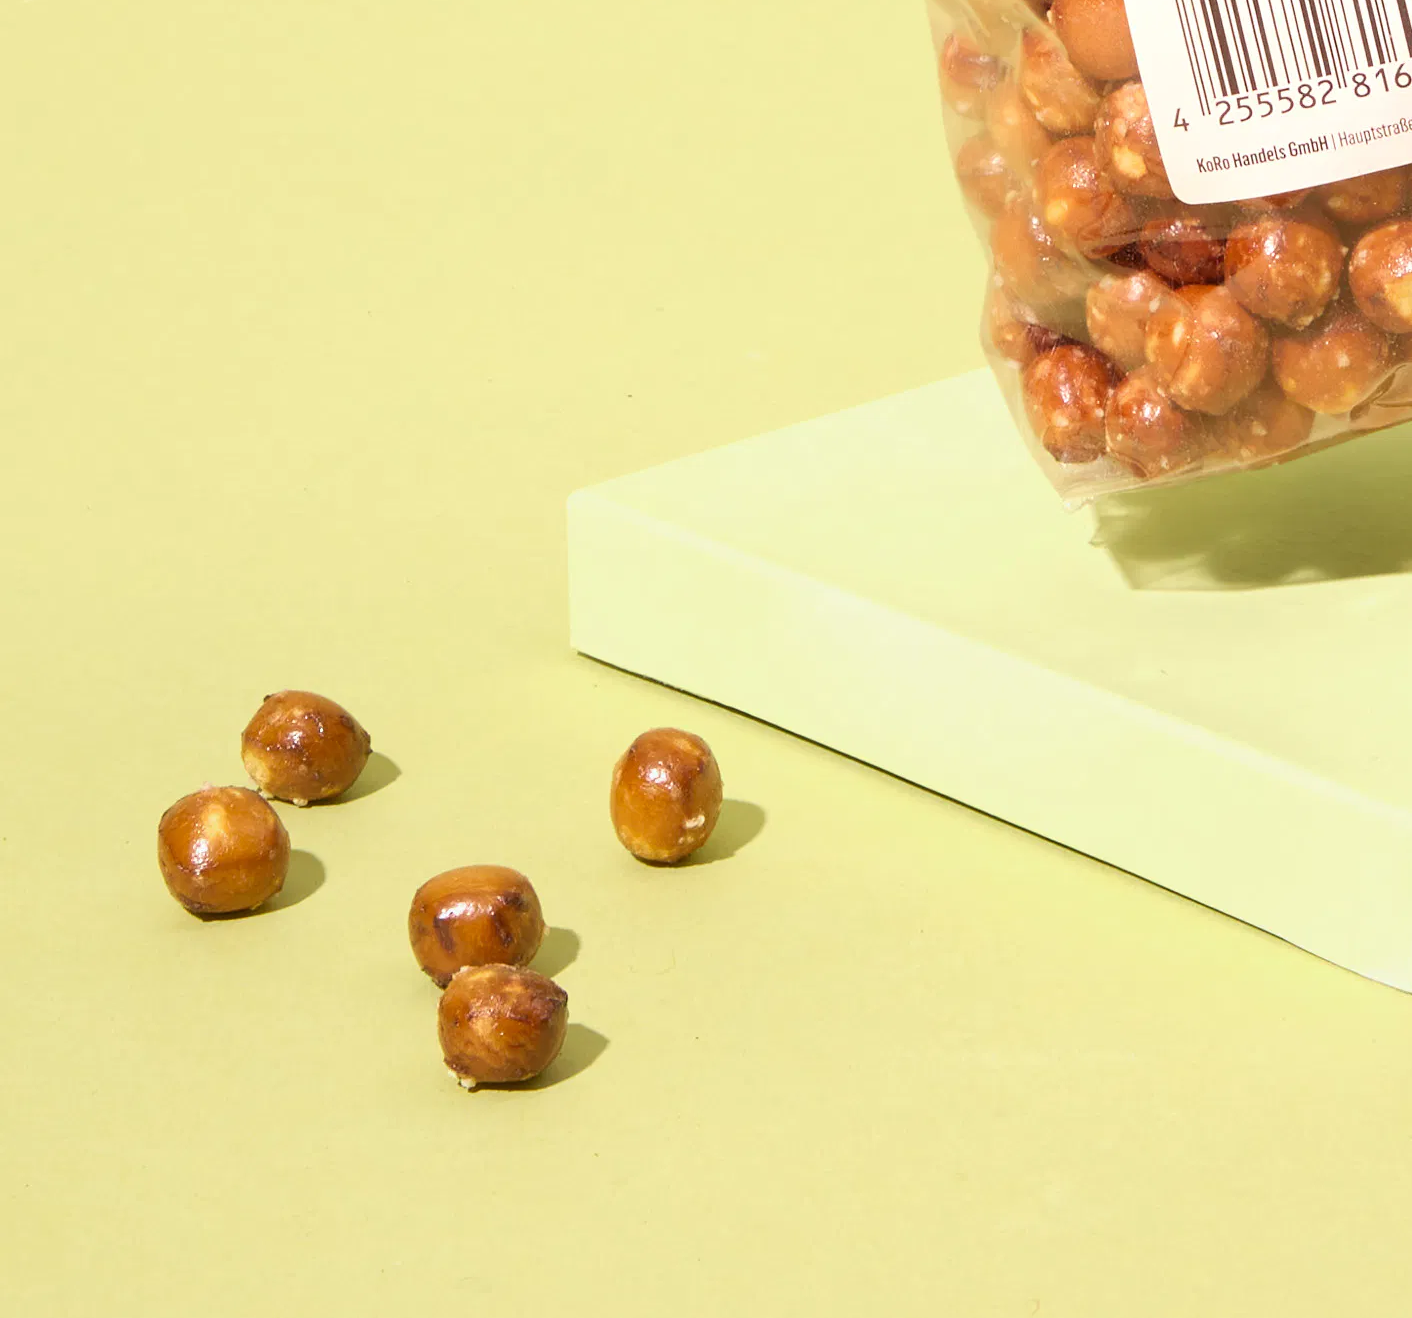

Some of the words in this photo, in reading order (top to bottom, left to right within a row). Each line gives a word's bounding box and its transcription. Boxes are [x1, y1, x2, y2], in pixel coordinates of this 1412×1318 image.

[1173, 107, 1190, 132] 4
[1215, 79, 1337, 126] 255582
[1196, 156, 1231, 173] KoRo
[1231, 145, 1287, 169] Handels
[1288, 135, 1329, 157] GmbH
